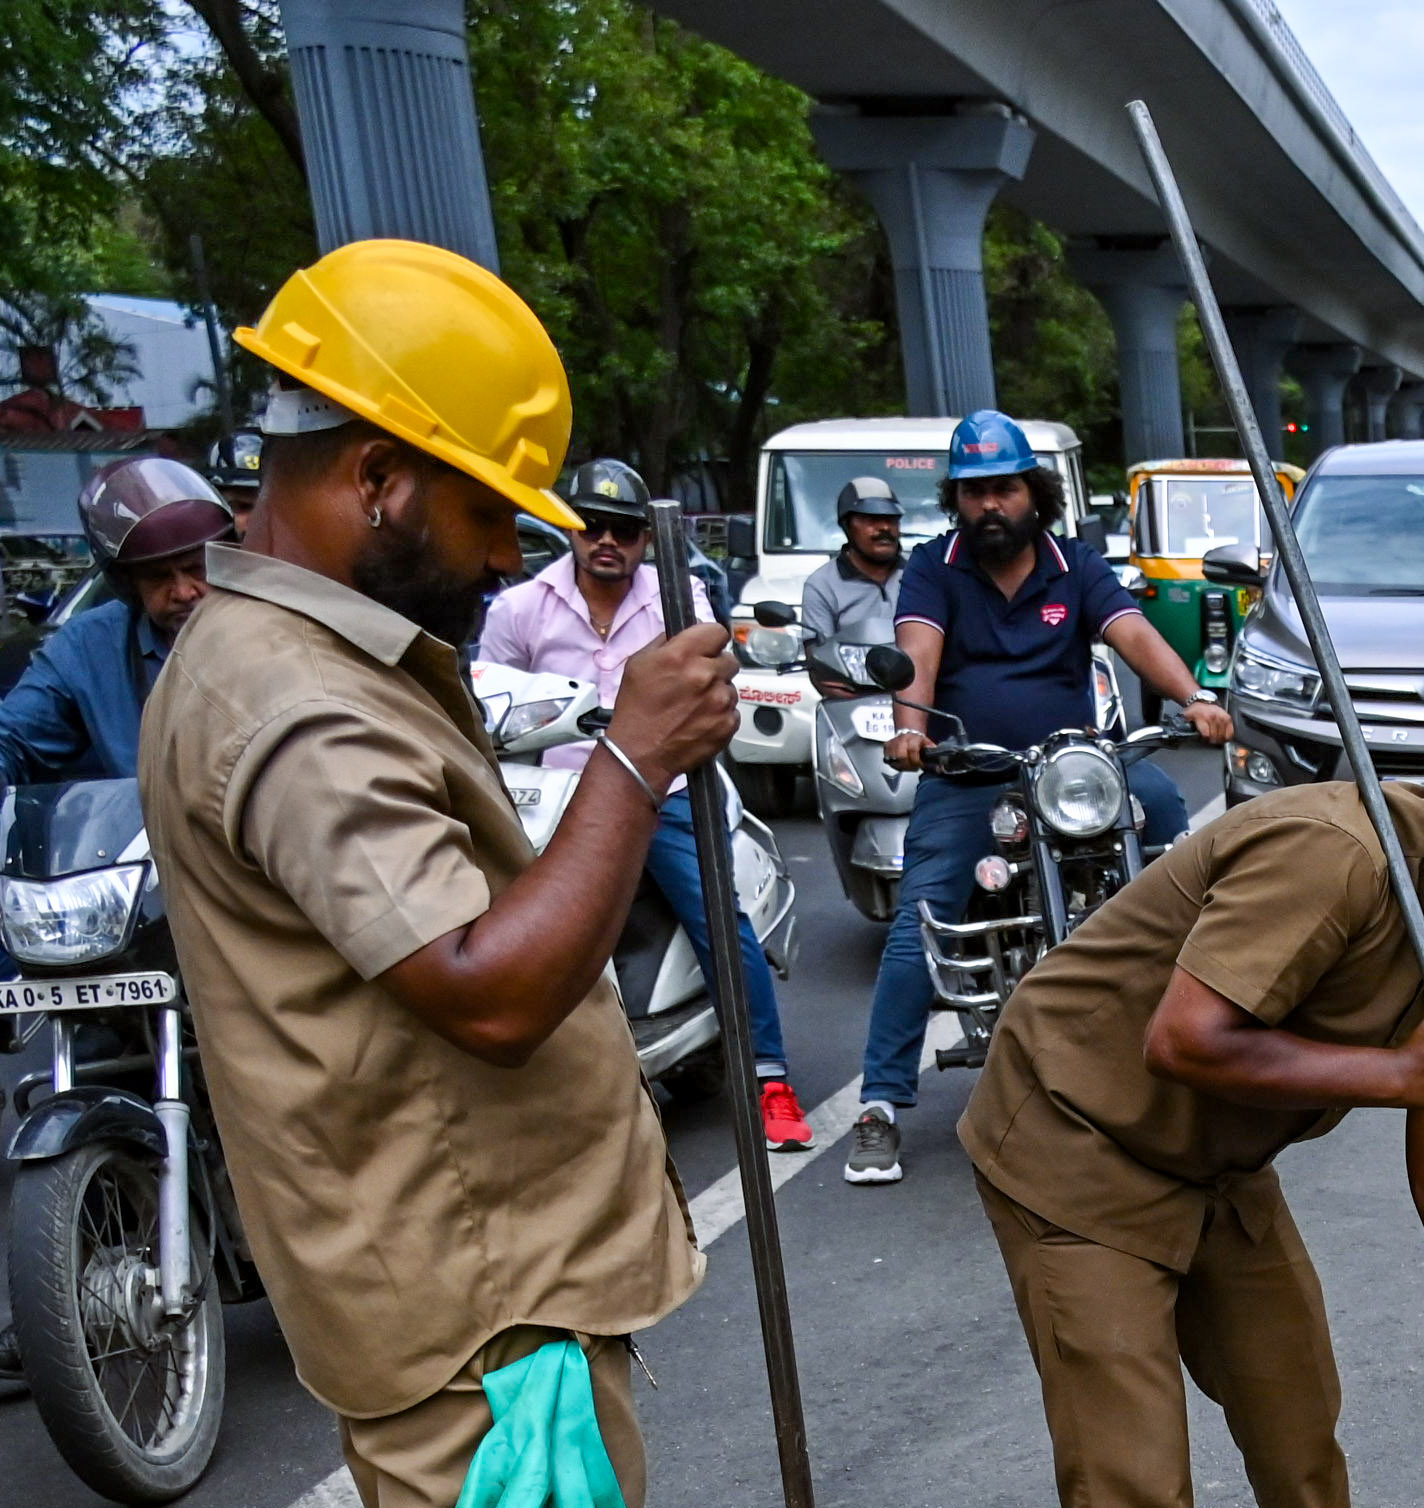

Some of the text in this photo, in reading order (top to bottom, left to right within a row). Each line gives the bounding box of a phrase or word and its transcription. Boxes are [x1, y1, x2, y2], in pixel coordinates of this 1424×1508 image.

[886, 456, 936, 470] POLICE
[75, 983, 101, 1004] ET
[115, 977, 166, 1003] 7961
